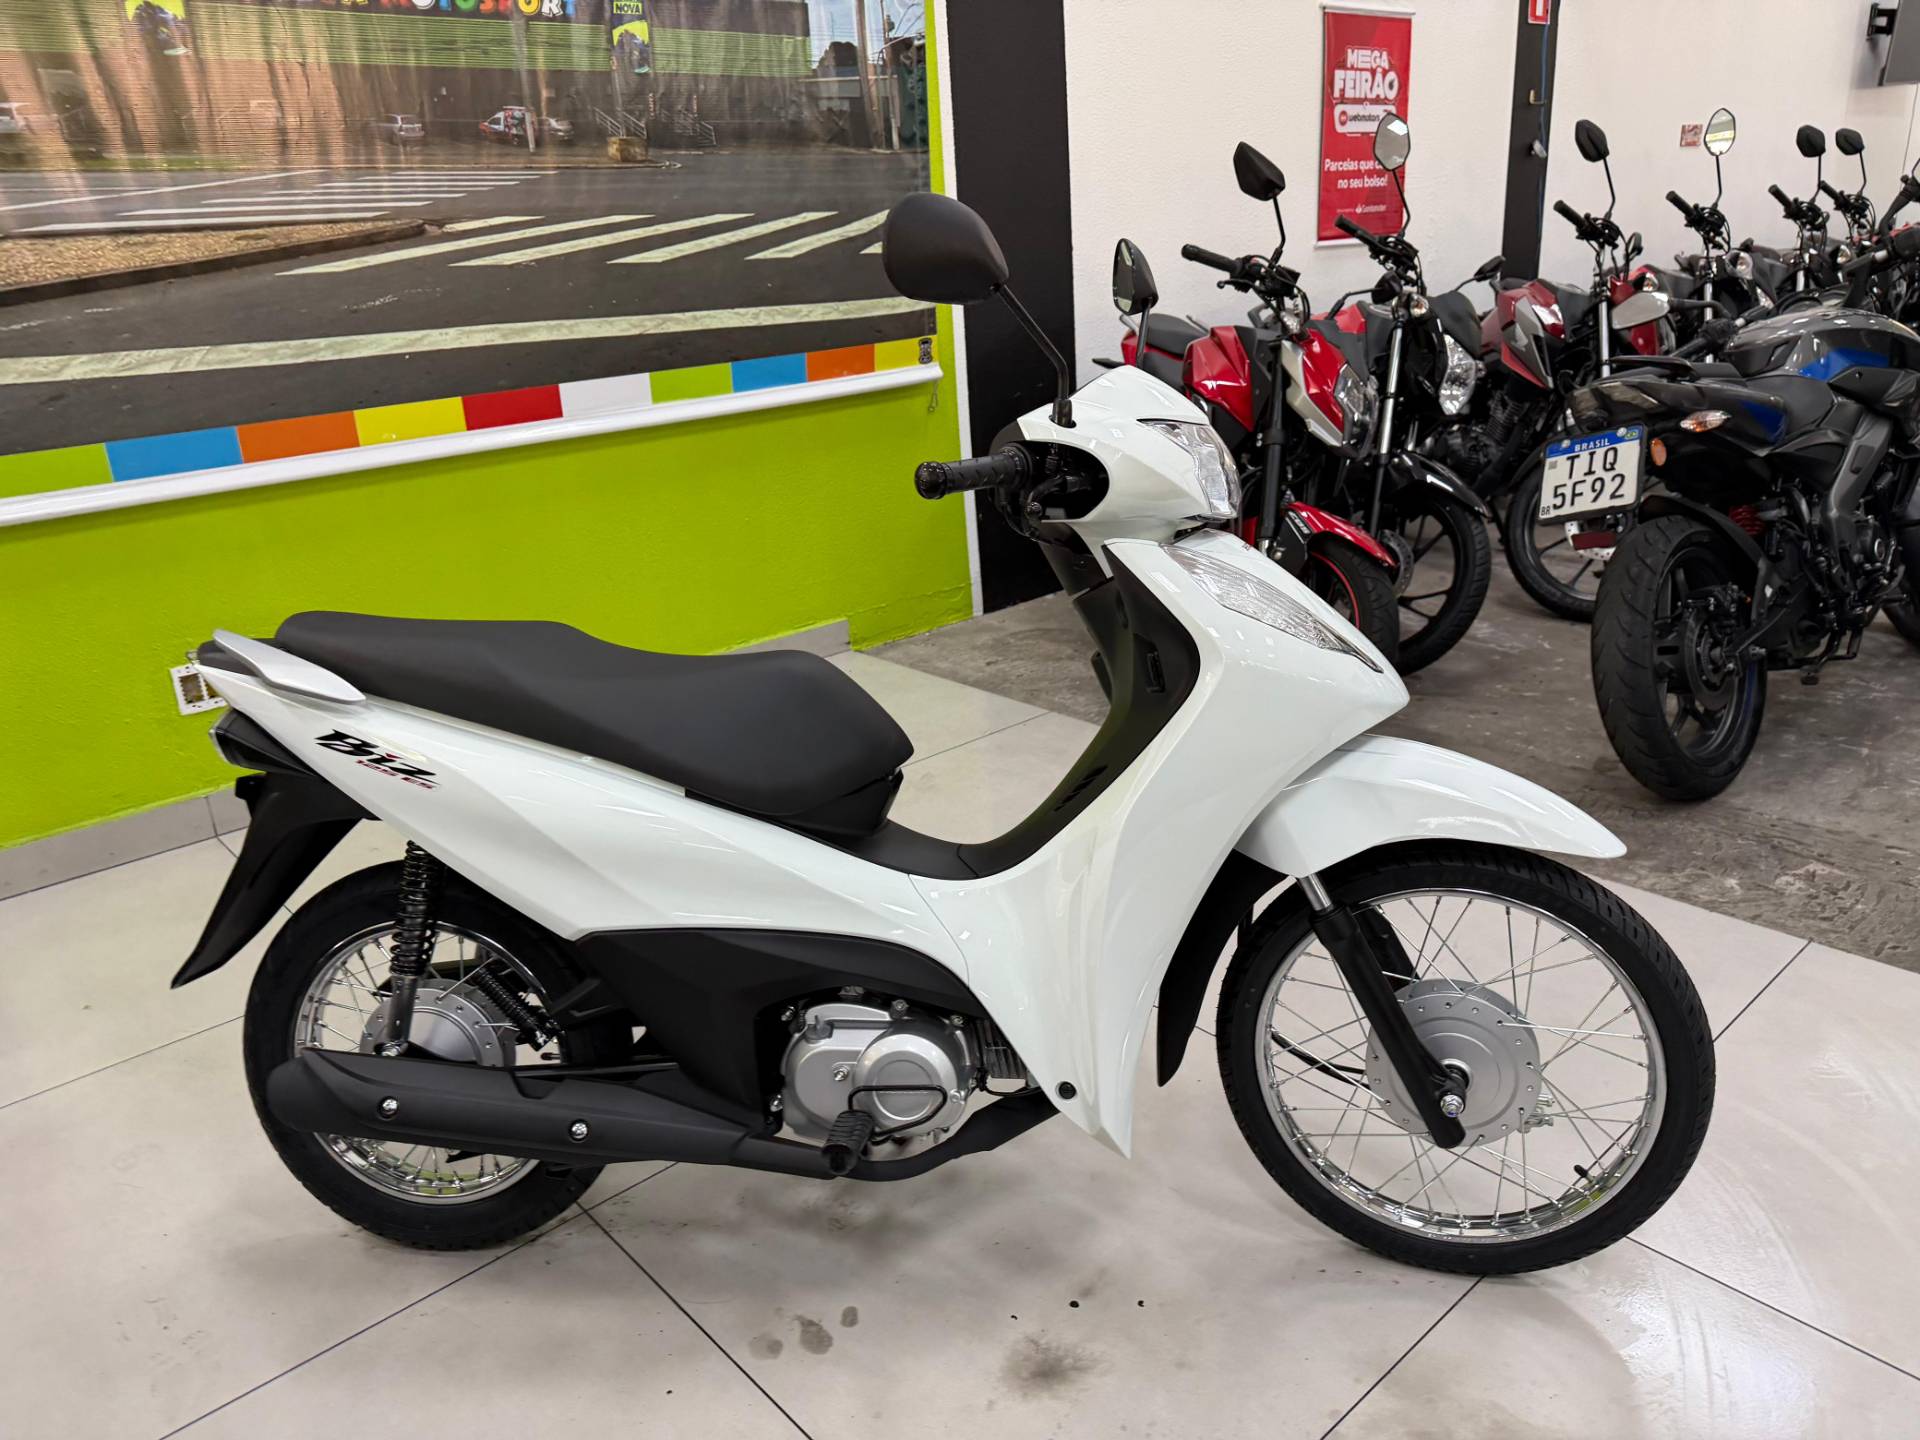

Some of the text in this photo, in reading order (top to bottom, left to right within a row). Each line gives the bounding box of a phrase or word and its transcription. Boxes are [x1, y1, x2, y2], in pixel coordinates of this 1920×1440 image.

[615, 3, 641, 13] NOVA
[1346, 48, 1389, 69] MEGA
[1333, 67, 1399, 100] FEIRÃO
[1324, 158, 1358, 171] Parcelas
[1359, 160, 1374, 173] que
[1337, 174, 1388, 189] no seu bolso!
[1574, 438, 1610, 452] BRASIL
[1566, 447, 1618, 480] TIQ
[1552, 474, 1626, 510] 5F92
[1541, 505, 1551, 517] BR
[314, 729, 441, 786] Biz
